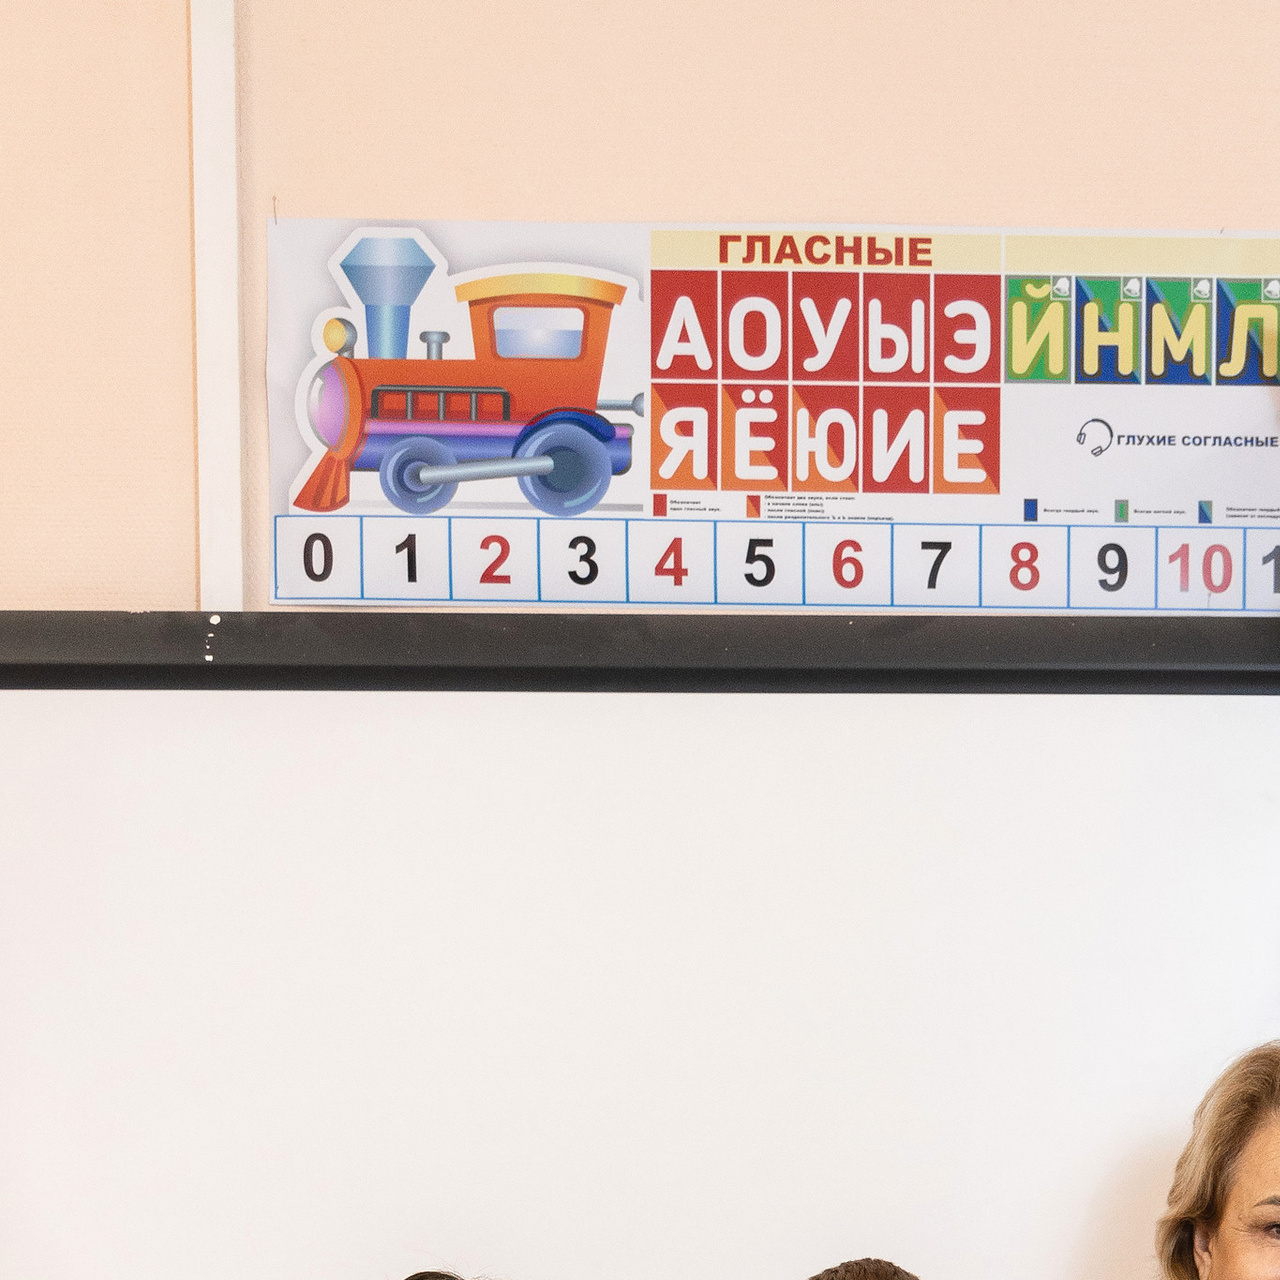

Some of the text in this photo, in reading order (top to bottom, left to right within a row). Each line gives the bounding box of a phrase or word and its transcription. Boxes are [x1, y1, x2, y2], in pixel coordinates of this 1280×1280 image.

[718, 234, 933, 267] ГЛАСНЫЕ
[655, 295, 713, 371] А
[799, 297, 853, 373] У
[868, 298, 926, 374] Ы
[943, 299, 992, 375] Э
[1010, 281, 1065, 378] Й
[658, 406, 709, 482] Я
[796, 406, 857, 483] Ю
[875, 408, 926, 485] И
[1116, 434, 1280, 448] ГЛУХИЕ СОГЛАСНЫЕ
[302, 532, 334, 583] 0
[394, 533, 418, 584] 1
[479, 535, 512, 585] 2
[567, 535, 600, 587] 3
[654, 537, 689, 588] 4
[744, 538, 776, 589] 5
[831, 539, 864, 590] 6
[920, 541, 953, 590] 7
[1008, 541, 1041, 592] 8
[1096, 542, 1129, 593] 9
[1167, 543, 1234, 594] 10
